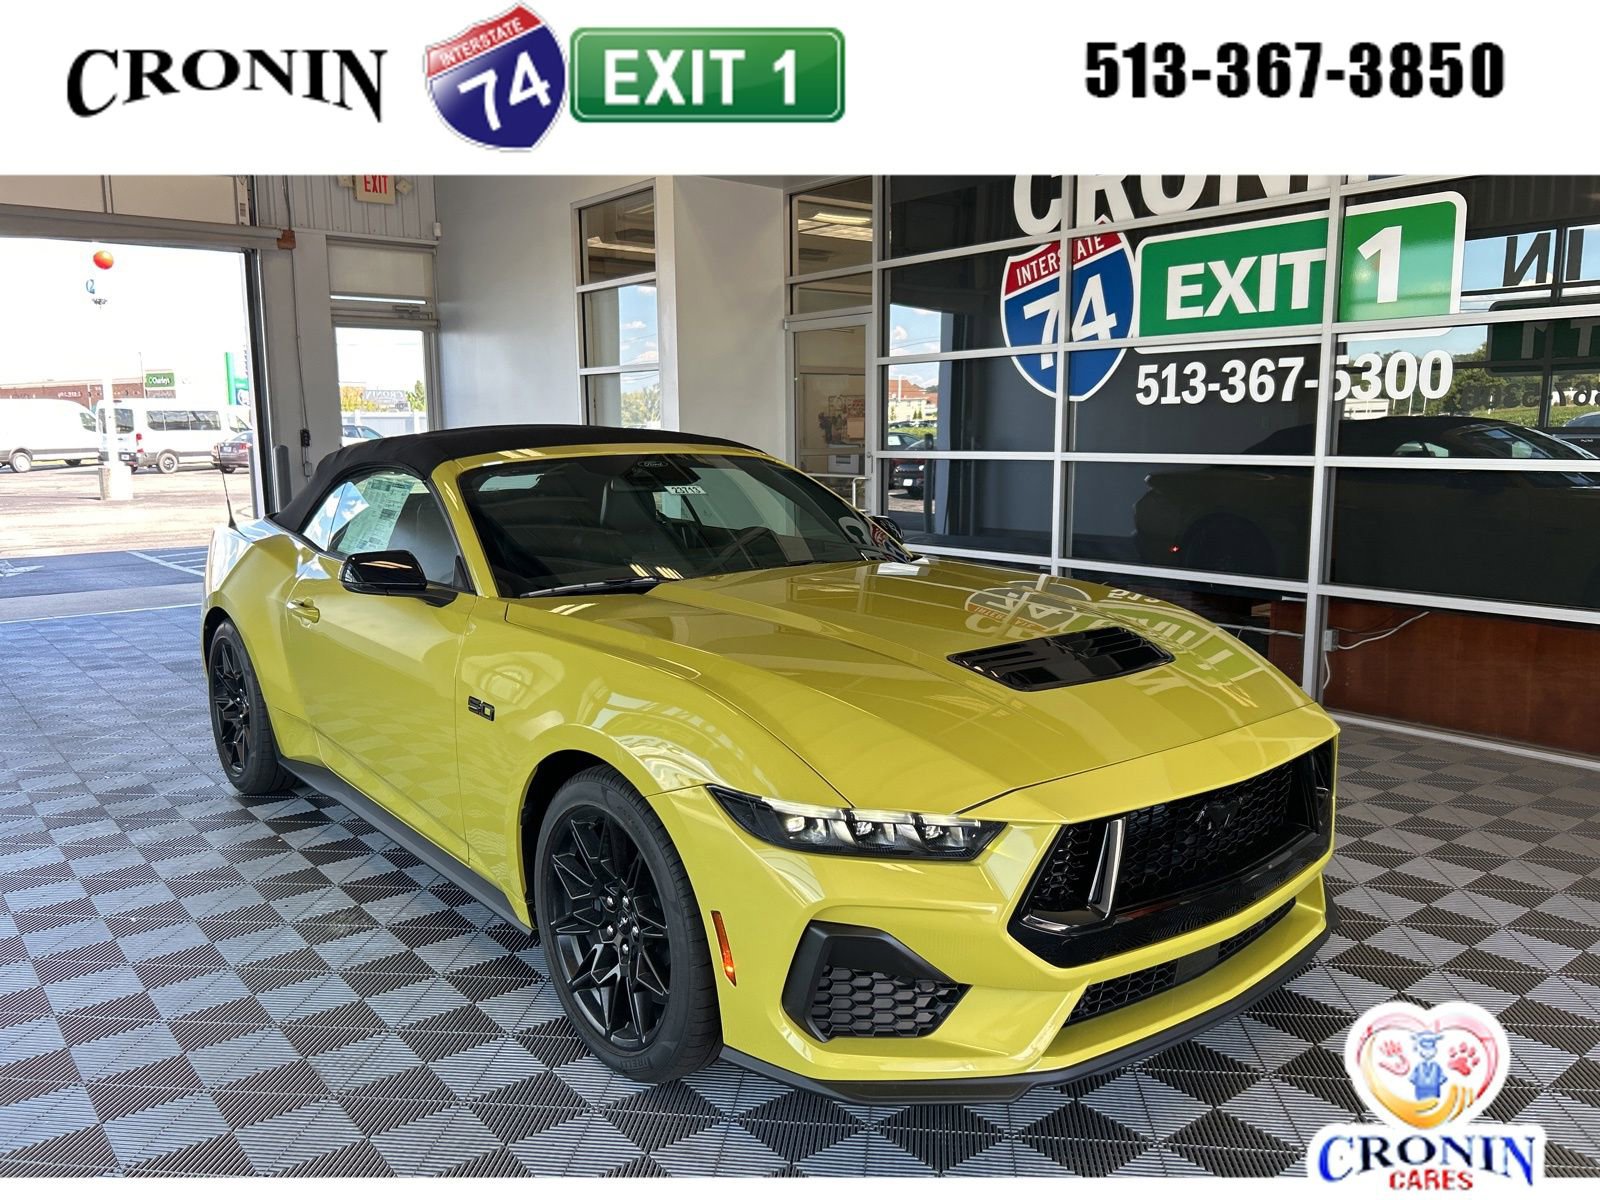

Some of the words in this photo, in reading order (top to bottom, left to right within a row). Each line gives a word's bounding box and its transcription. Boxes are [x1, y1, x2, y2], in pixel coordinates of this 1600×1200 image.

[363, 174, 388, 194] EXIT
[1015, 232, 1106, 287] INTERSATE
[1166, 248, 1327, 321] EXIT
[1357, 225, 1402, 304] 1
[1022, 273, 1118, 371] 74
[1135, 350, 1453, 406] 513-367-5300
